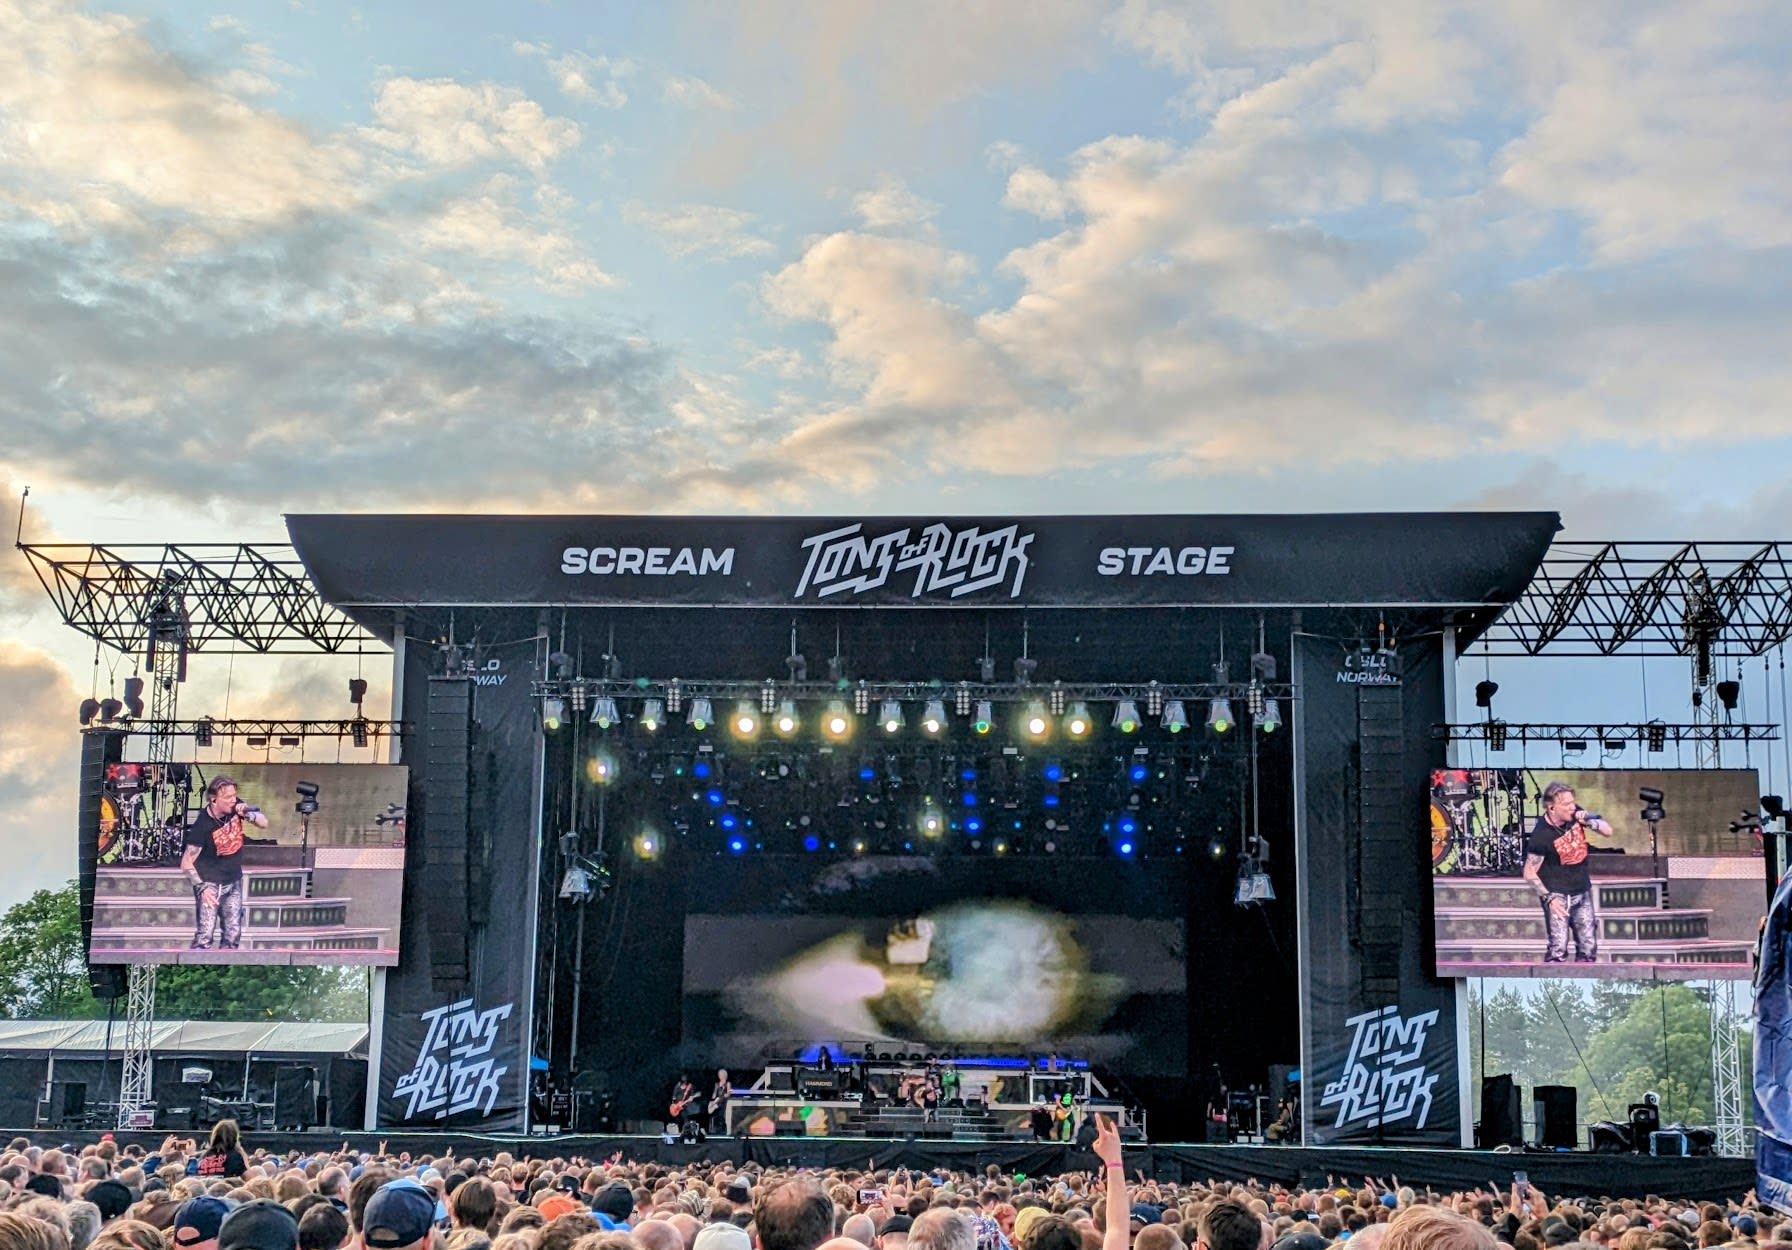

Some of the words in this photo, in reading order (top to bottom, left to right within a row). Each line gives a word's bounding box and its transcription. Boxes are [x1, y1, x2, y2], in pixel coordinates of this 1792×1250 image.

[561, 547, 735, 575] SCREAM
[896, 523, 1035, 597] ROCK
[1097, 546, 1235, 575] STAGE
